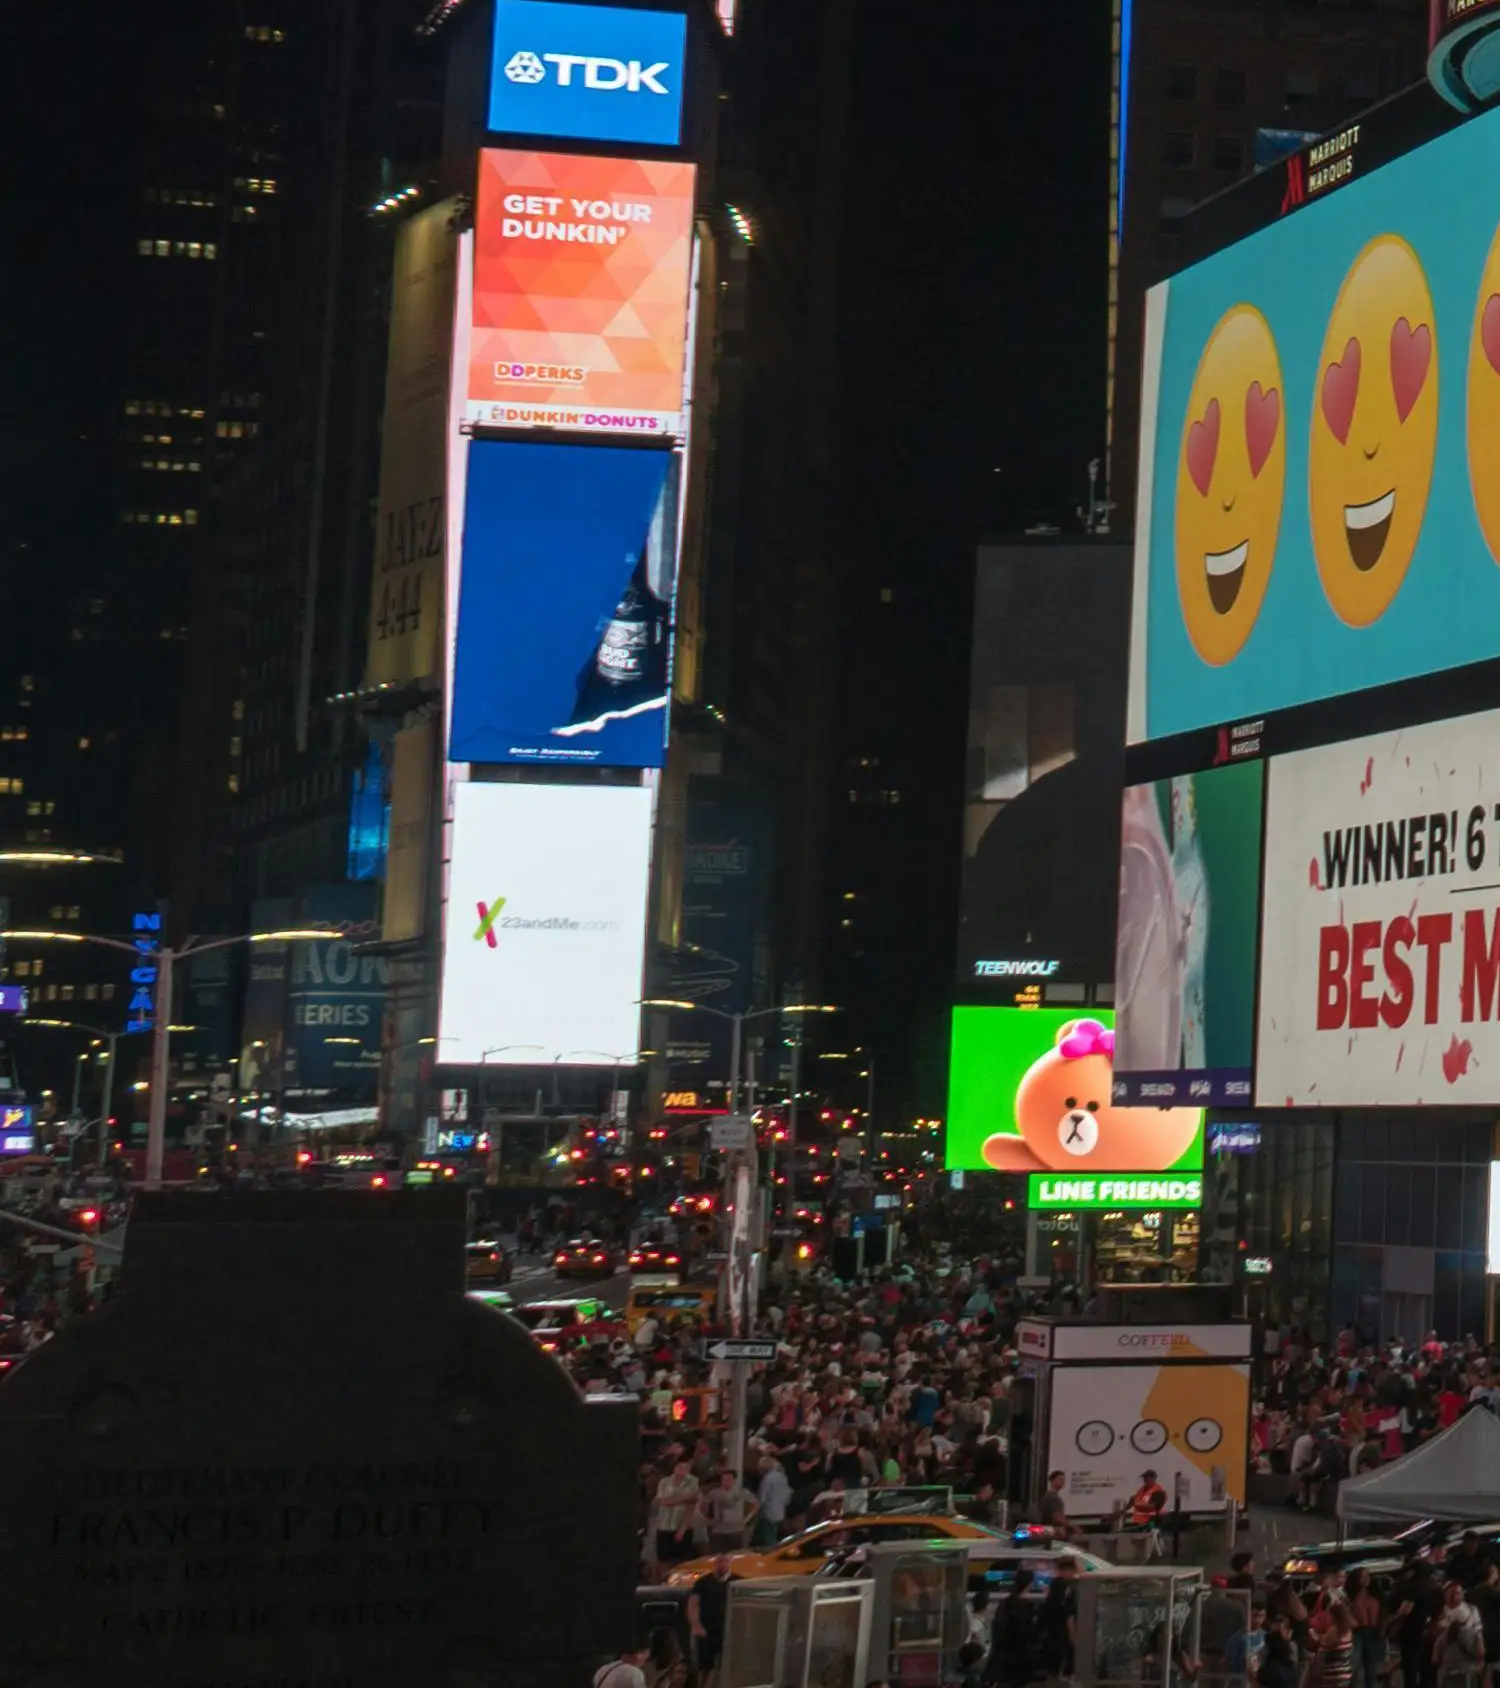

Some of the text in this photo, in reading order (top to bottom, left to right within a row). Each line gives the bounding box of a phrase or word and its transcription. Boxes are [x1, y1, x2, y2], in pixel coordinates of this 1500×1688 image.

[544, 53, 669, 95] TDK
[1309, 125, 1360, 166] MARRIOTT
[1308, 156, 1353, 192] MARQUIS
[503, 194, 651, 223] GET YOUR
[1323, 810, 1457, 889] WINNER!
[1465, 805, 1487, 872] 6
[1316, 912, 1453, 1031] BEST
[1039, 1181, 1201, 1201] LINE FRIENDS
